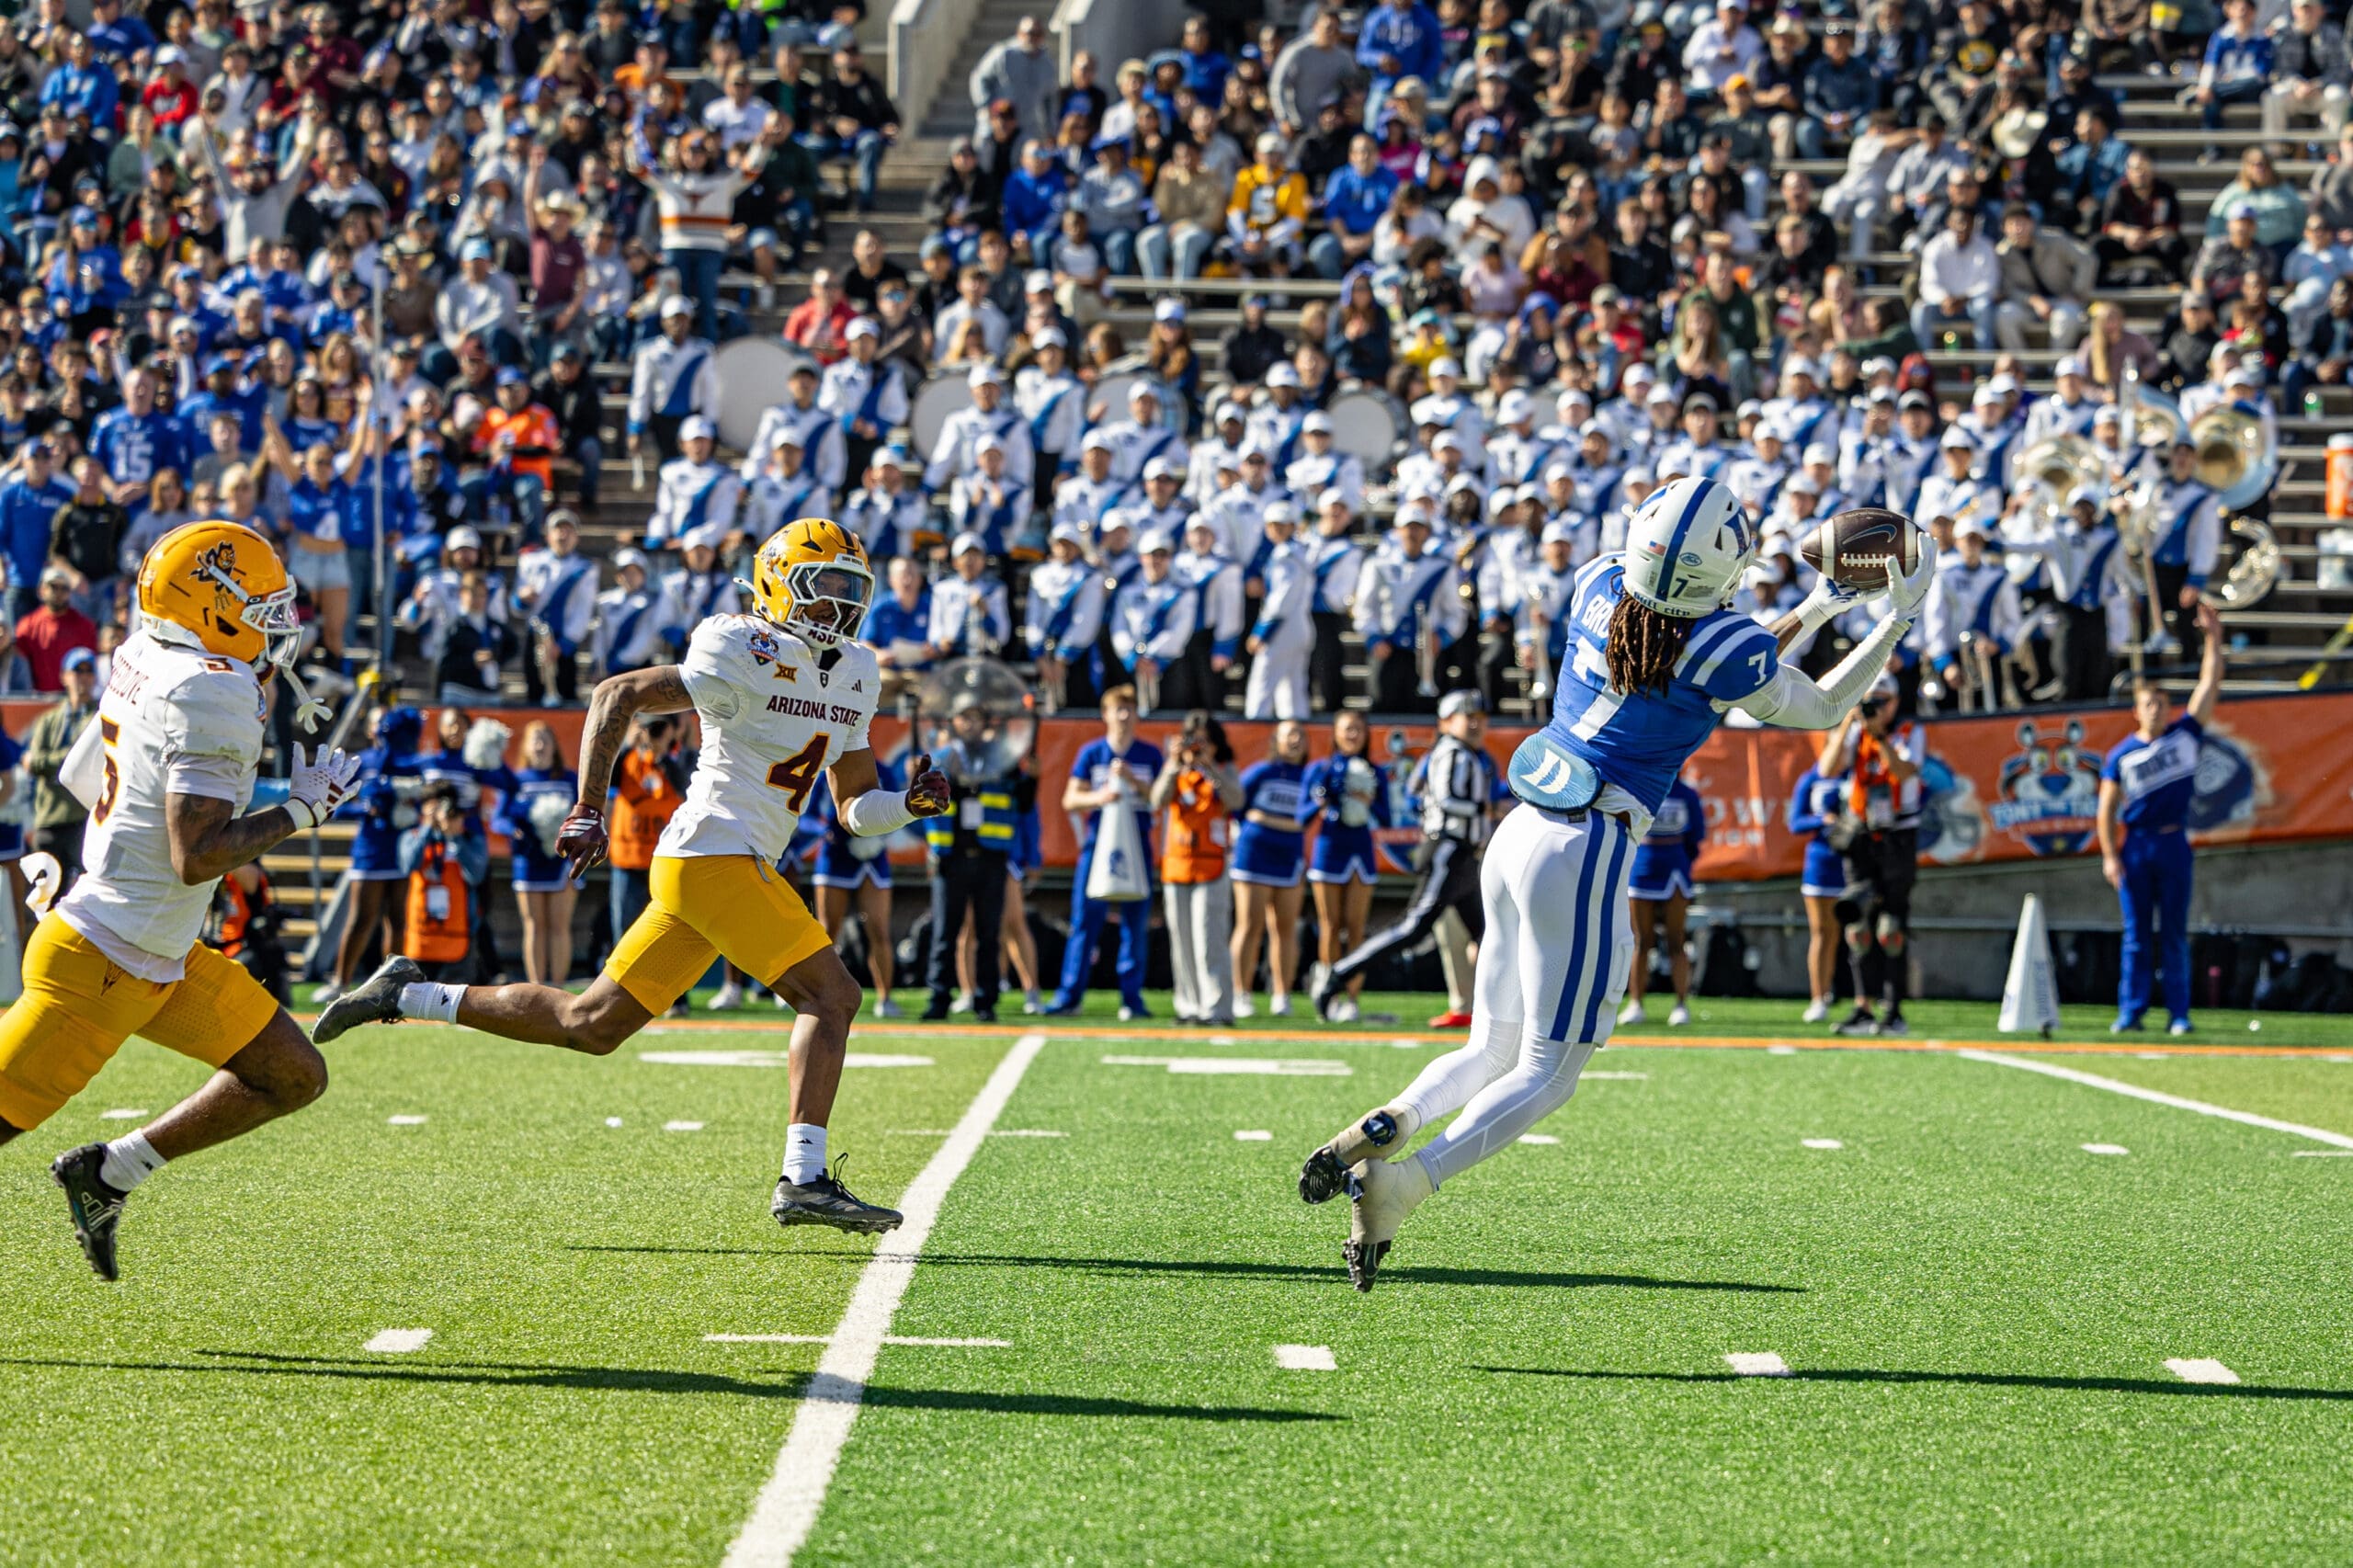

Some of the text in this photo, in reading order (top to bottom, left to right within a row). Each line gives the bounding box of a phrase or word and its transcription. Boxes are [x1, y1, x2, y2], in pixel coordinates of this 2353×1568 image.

[1672, 577, 1688, 598] 7
[1748, 651, 1767, 686] 7
[767, 695, 862, 727] ARIZONA STATE
[94, 714, 120, 826] 5
[766, 732, 830, 816] 4
